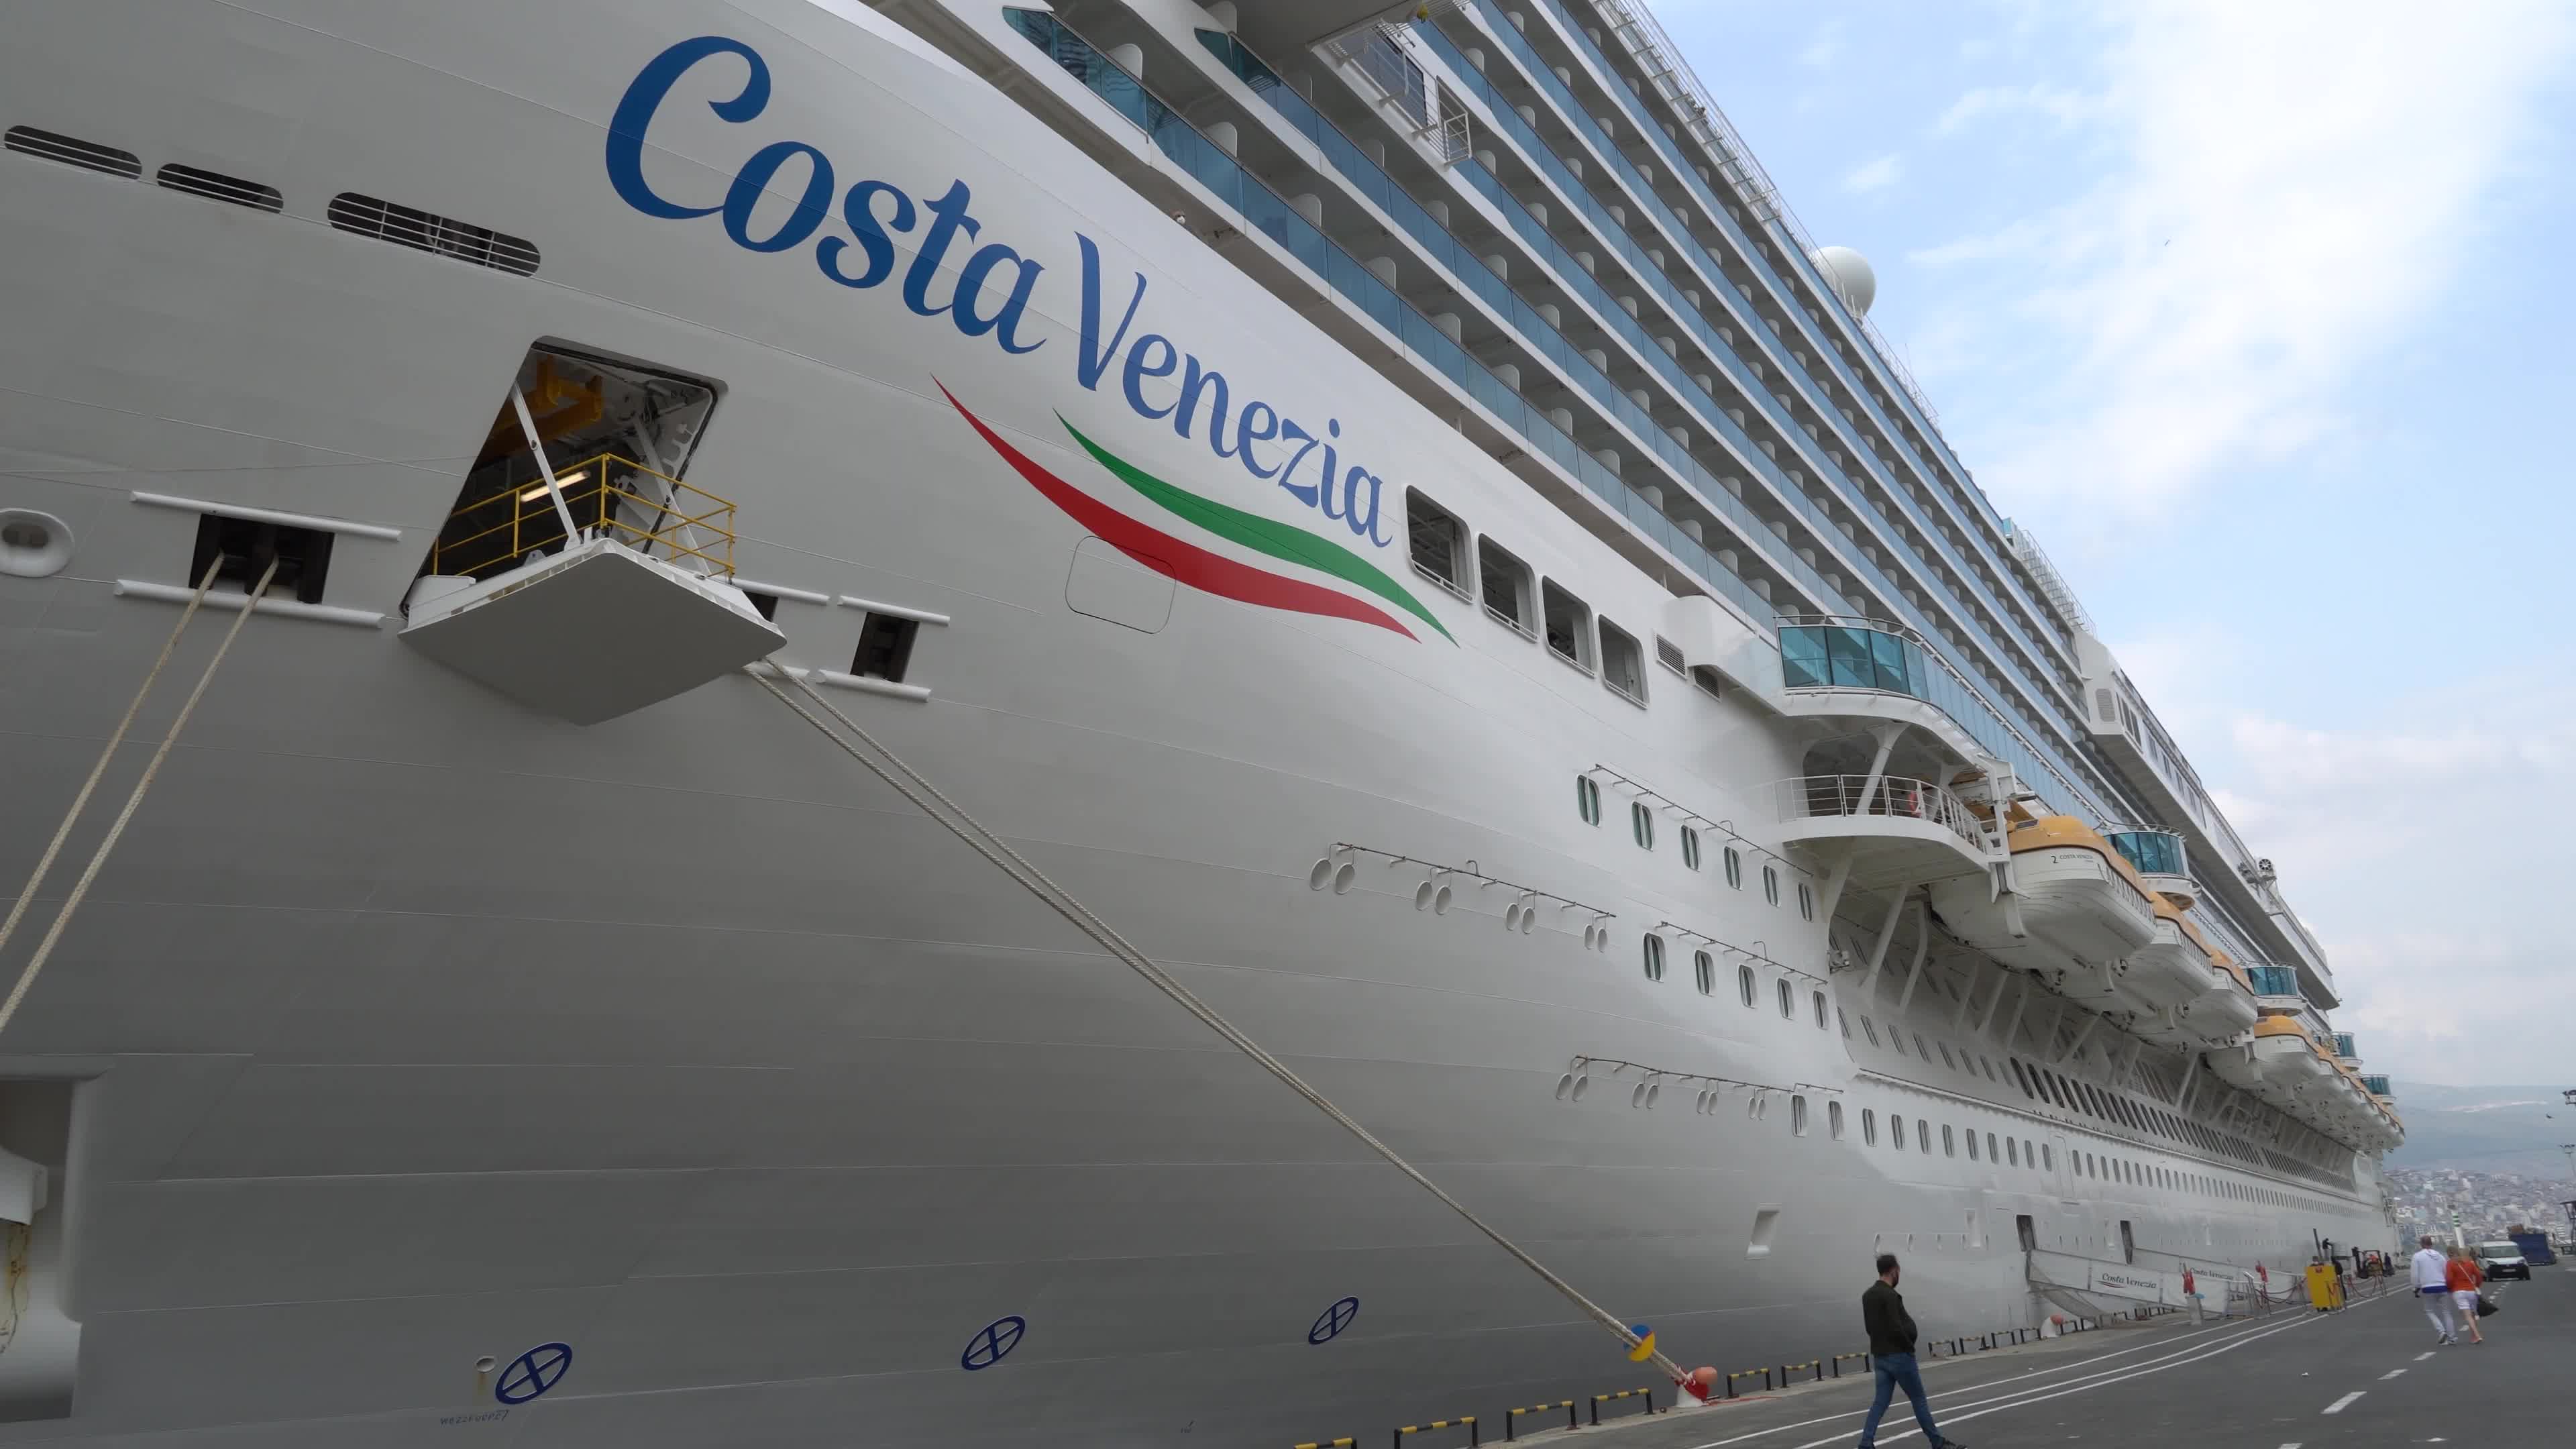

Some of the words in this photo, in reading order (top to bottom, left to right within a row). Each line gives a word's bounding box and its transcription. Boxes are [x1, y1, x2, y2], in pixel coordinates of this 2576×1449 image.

[606, 36, 1047, 354] Costa
[1074, 231, 1393, 547] Venezia
[2051, 855, 2059, 863] 2
[2102, 1273, 2125, 1283] Costa
[2126, 1276, 2157, 1289] Venezia
